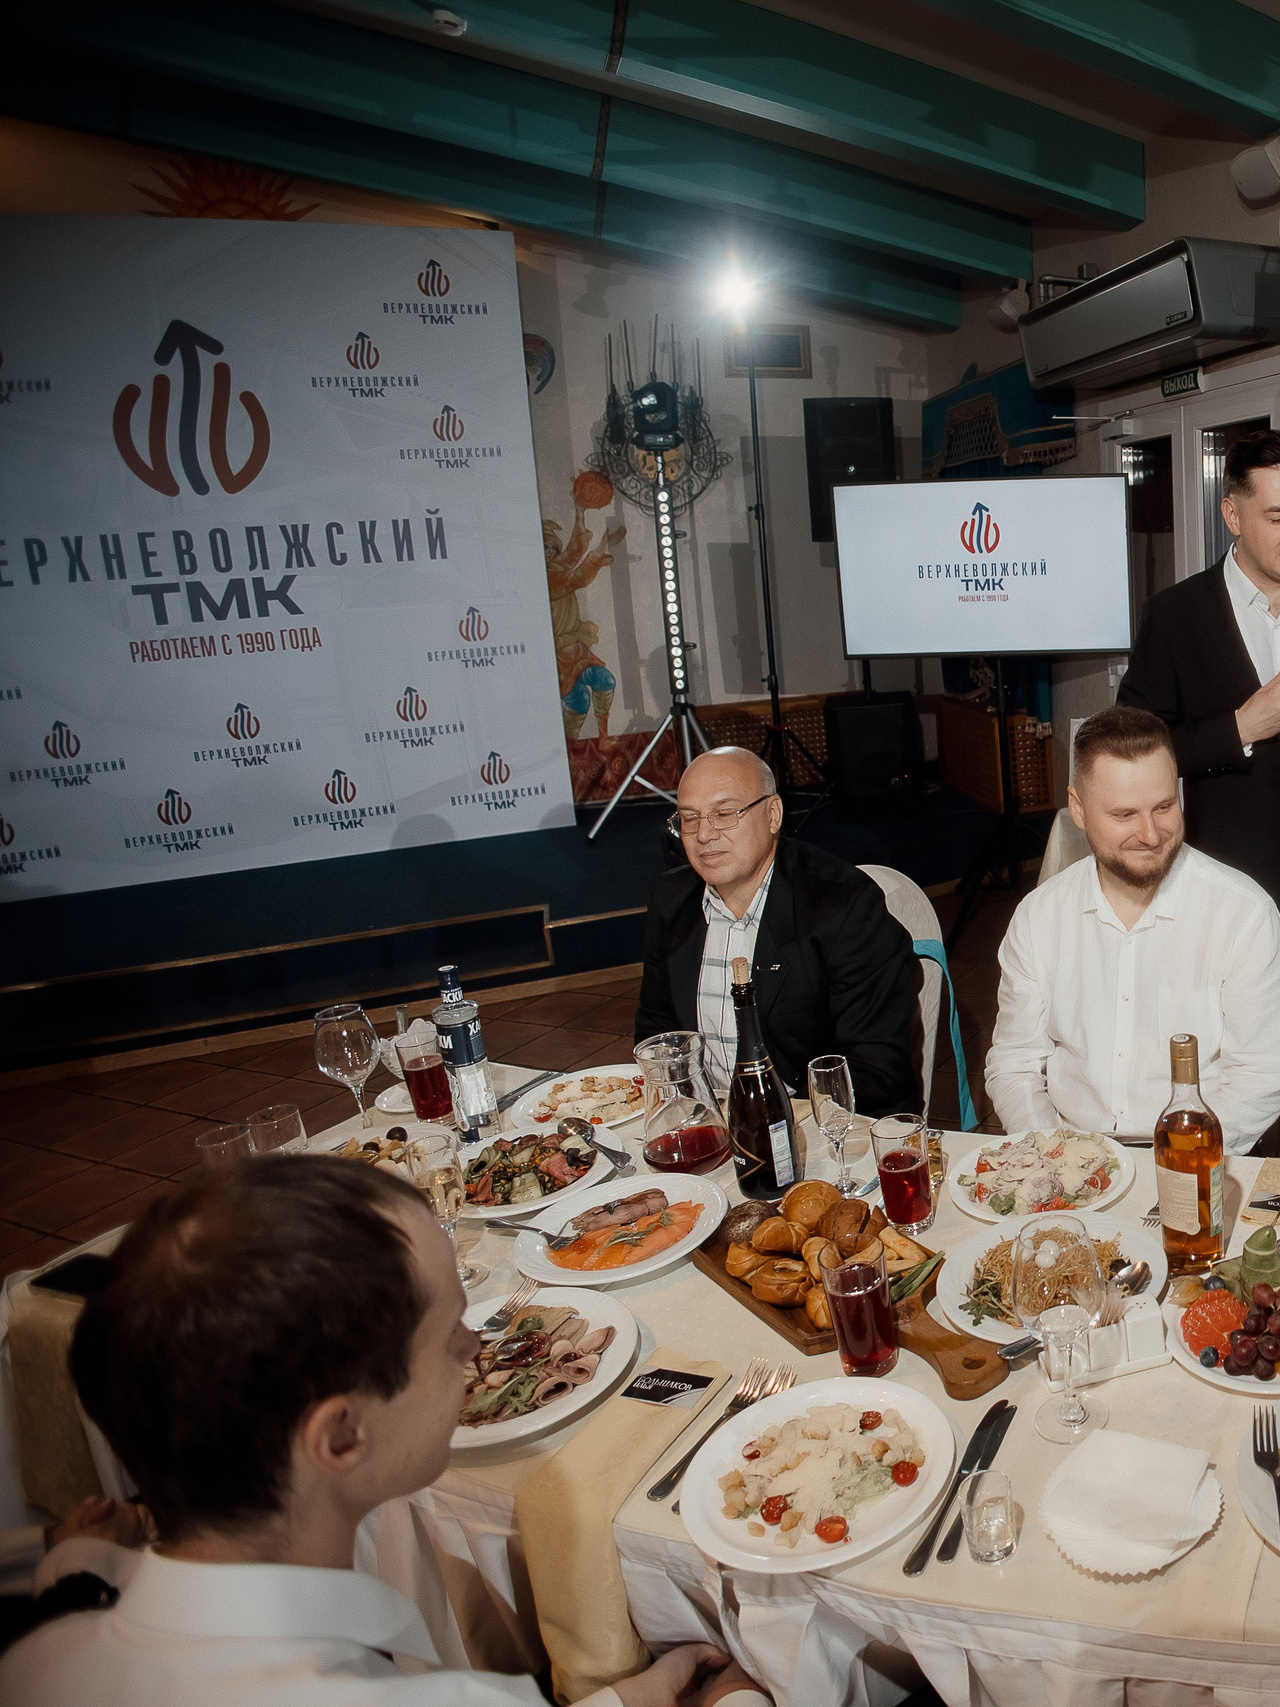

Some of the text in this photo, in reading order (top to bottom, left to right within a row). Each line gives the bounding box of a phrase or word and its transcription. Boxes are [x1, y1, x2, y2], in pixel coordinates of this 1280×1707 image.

[383, 302, 488, 316] ВЕРХНЕВОЛЖСКИЙ
[418, 314, 455, 325] ТМК
[311, 374, 419, 389] ВЕРХНЕВОЛЖСКИЙ
[1164, 374, 1195, 392] ВЫХОД
[348, 387, 385, 398] ТМК
[400, 446, 502, 460] ВЕРХНЕВОЛЖСКИЙ
[435, 458, 470, 469] ТМК
[918, 558, 1047, 579] ВЕРХНЕВОЛЖСКИЙ
[961, 578, 1004, 591] ТМК
[131, 573, 305, 626] ТМК
[129, 626, 323, 664] РАБОТАЕМ С 1990 ГОДА
[427, 643, 526, 662] ВЕРХНЕВОЛЖСКИЙ
[461, 656, 495, 669] ТМК
[365, 721, 466, 743] ВЕРХНЕВОЛЖСКИЙ
[399, 735, 435, 748] ТМК
[193, 739, 303, 762] ВЕРХНЕВОЛЖСКИЙ
[231, 755, 269, 768] ТМК
[9, 758, 127, 783] ВЕРХНЕВОЛЖСКИЙ
[50, 773, 92, 788] ТМК
[450, 783, 547, 806] ВЕРХНЕВОЛЖСКИЙ
[483, 798, 518, 812] ТМК
[293, 803, 397, 827] ВЕРХНЕВОЛЖСКИЙ
[328, 818, 365, 832] ТМК
[124, 823, 235, 849] ВЕРХНЕВОЛЖСКИЙ
[163, 839, 201, 853] ТМК
[442, 990, 463, 1002] АСКИ
[639, 1376, 692, 1390] БОЛЬШАКОВ
